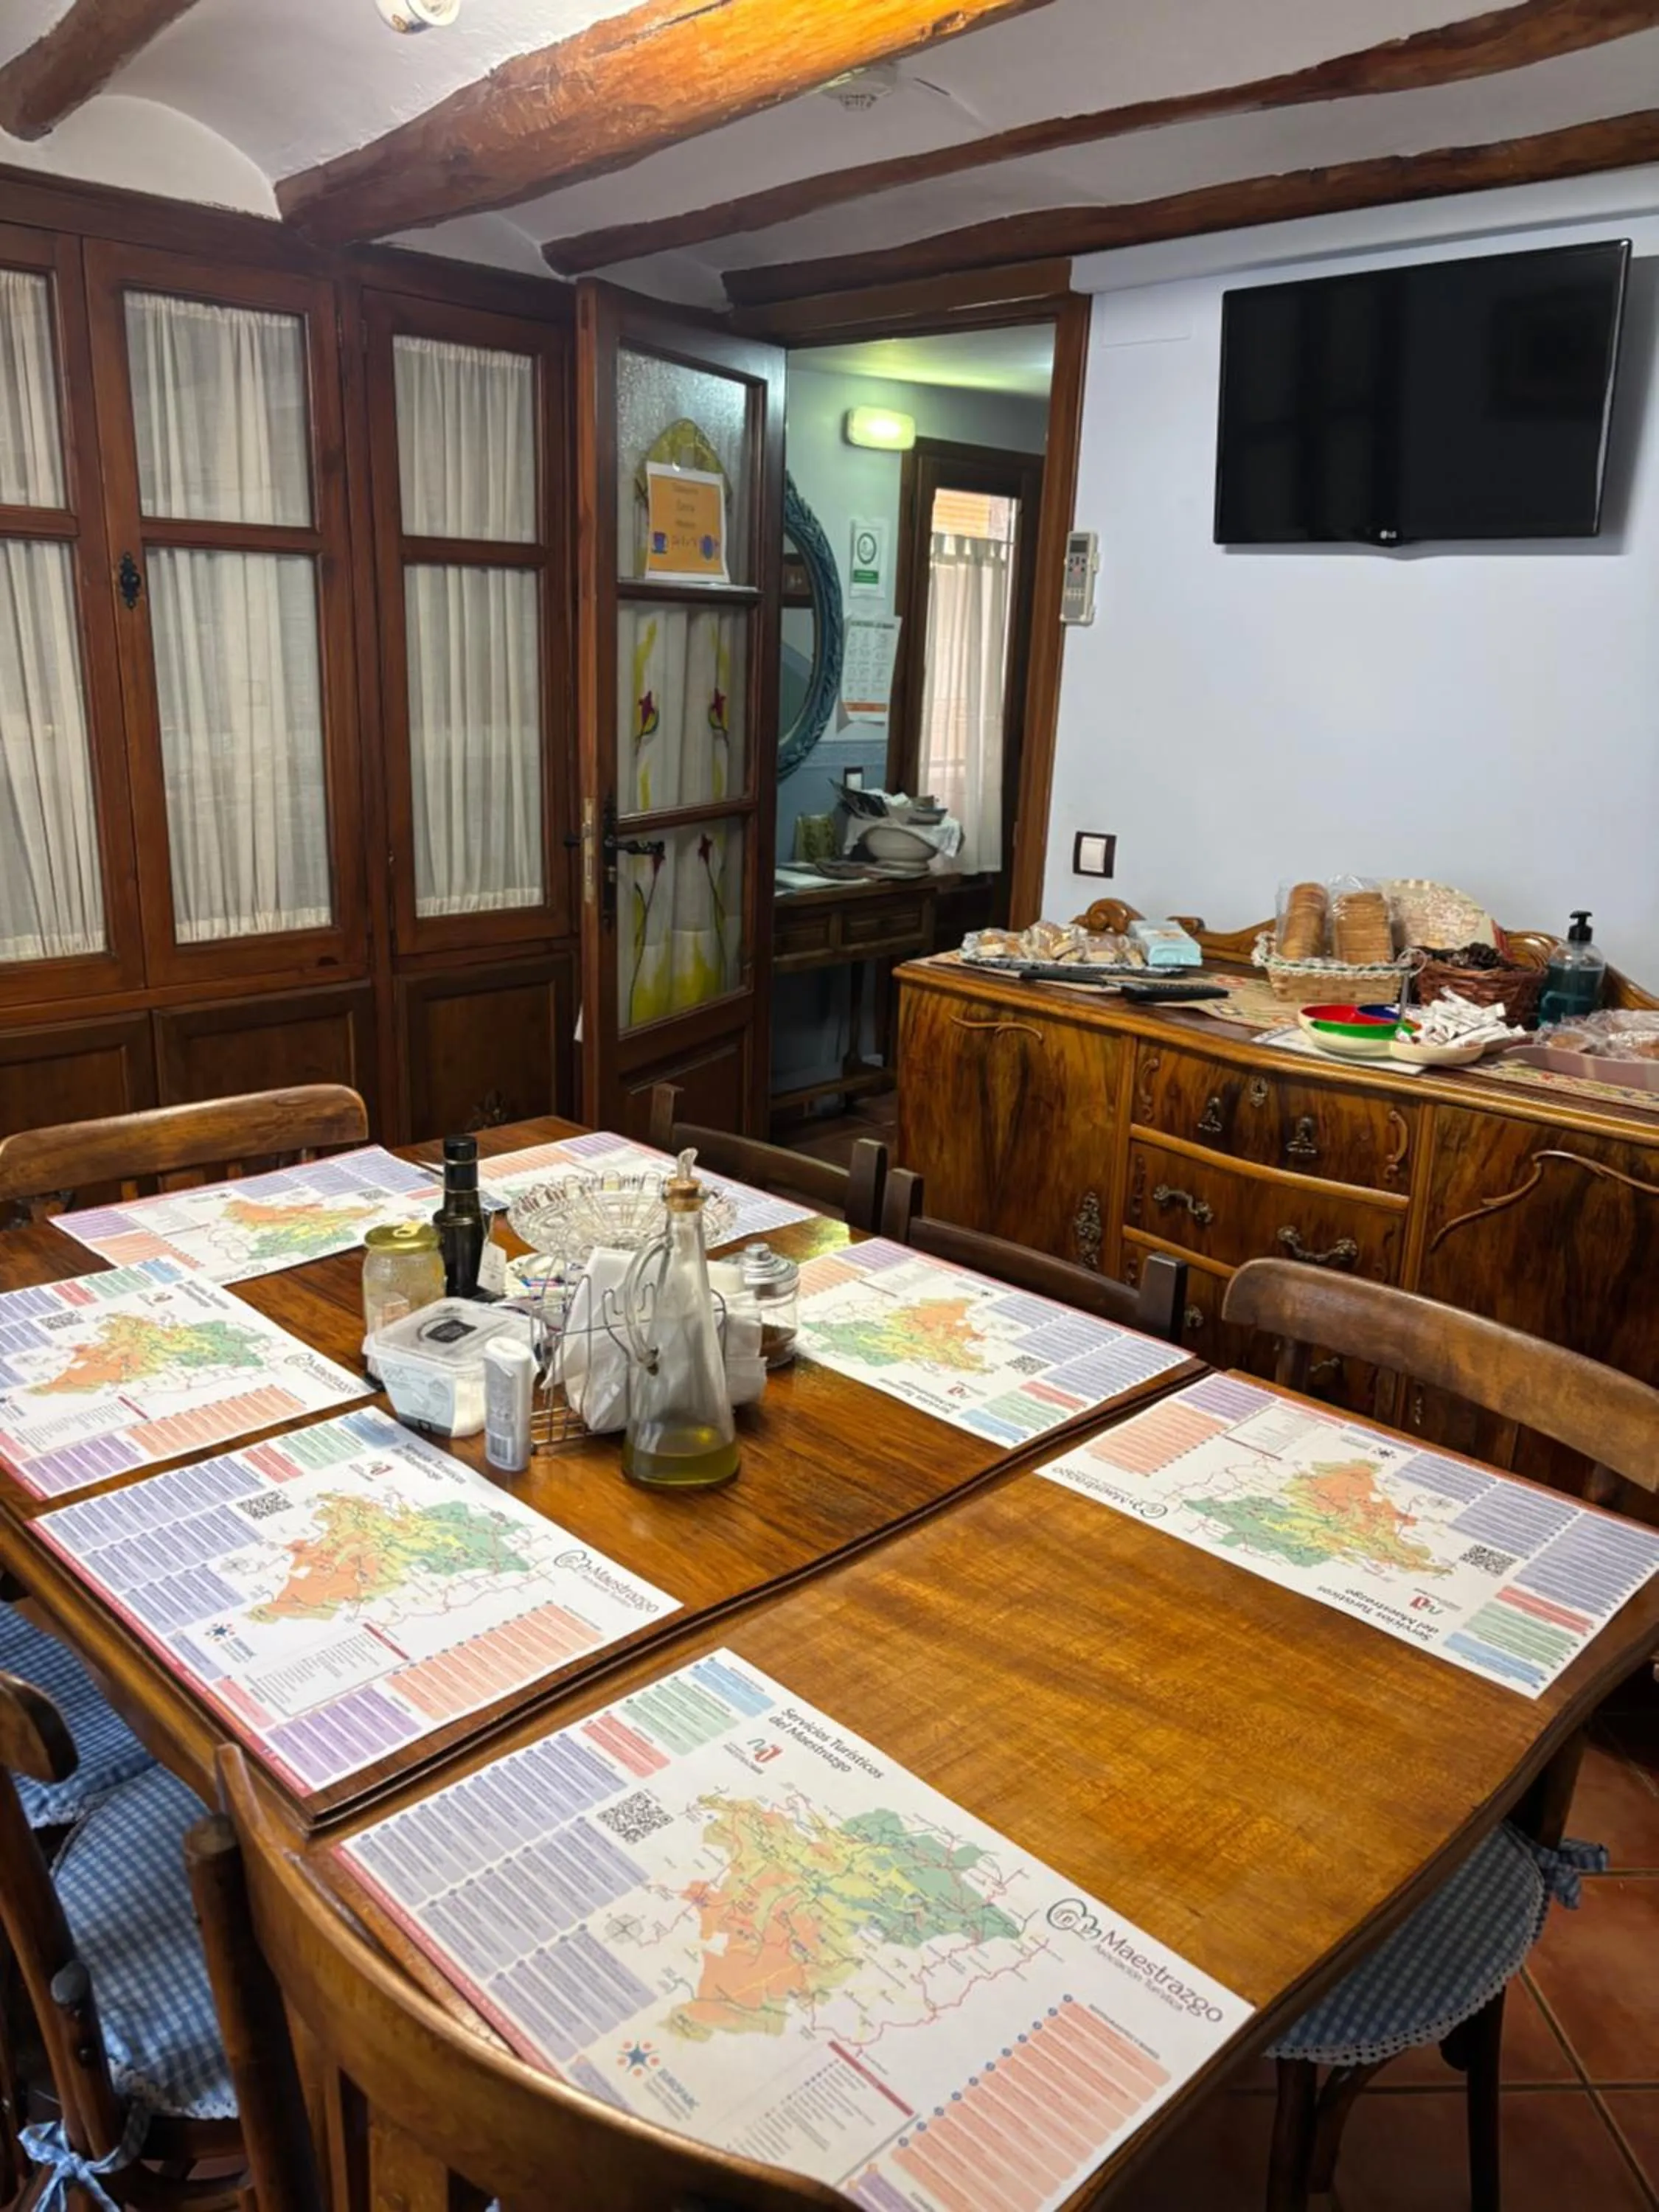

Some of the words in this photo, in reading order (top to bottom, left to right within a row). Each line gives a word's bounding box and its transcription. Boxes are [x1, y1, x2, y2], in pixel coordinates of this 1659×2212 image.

[768, 1715, 791, 1731] del
[786, 1727, 852, 1773] Maestrazgo
[781, 1707, 830, 1742] Servicios
[830, 1738, 885, 1779] Turísticos
[1100, 1930, 1224, 2023] Maestrazgo
